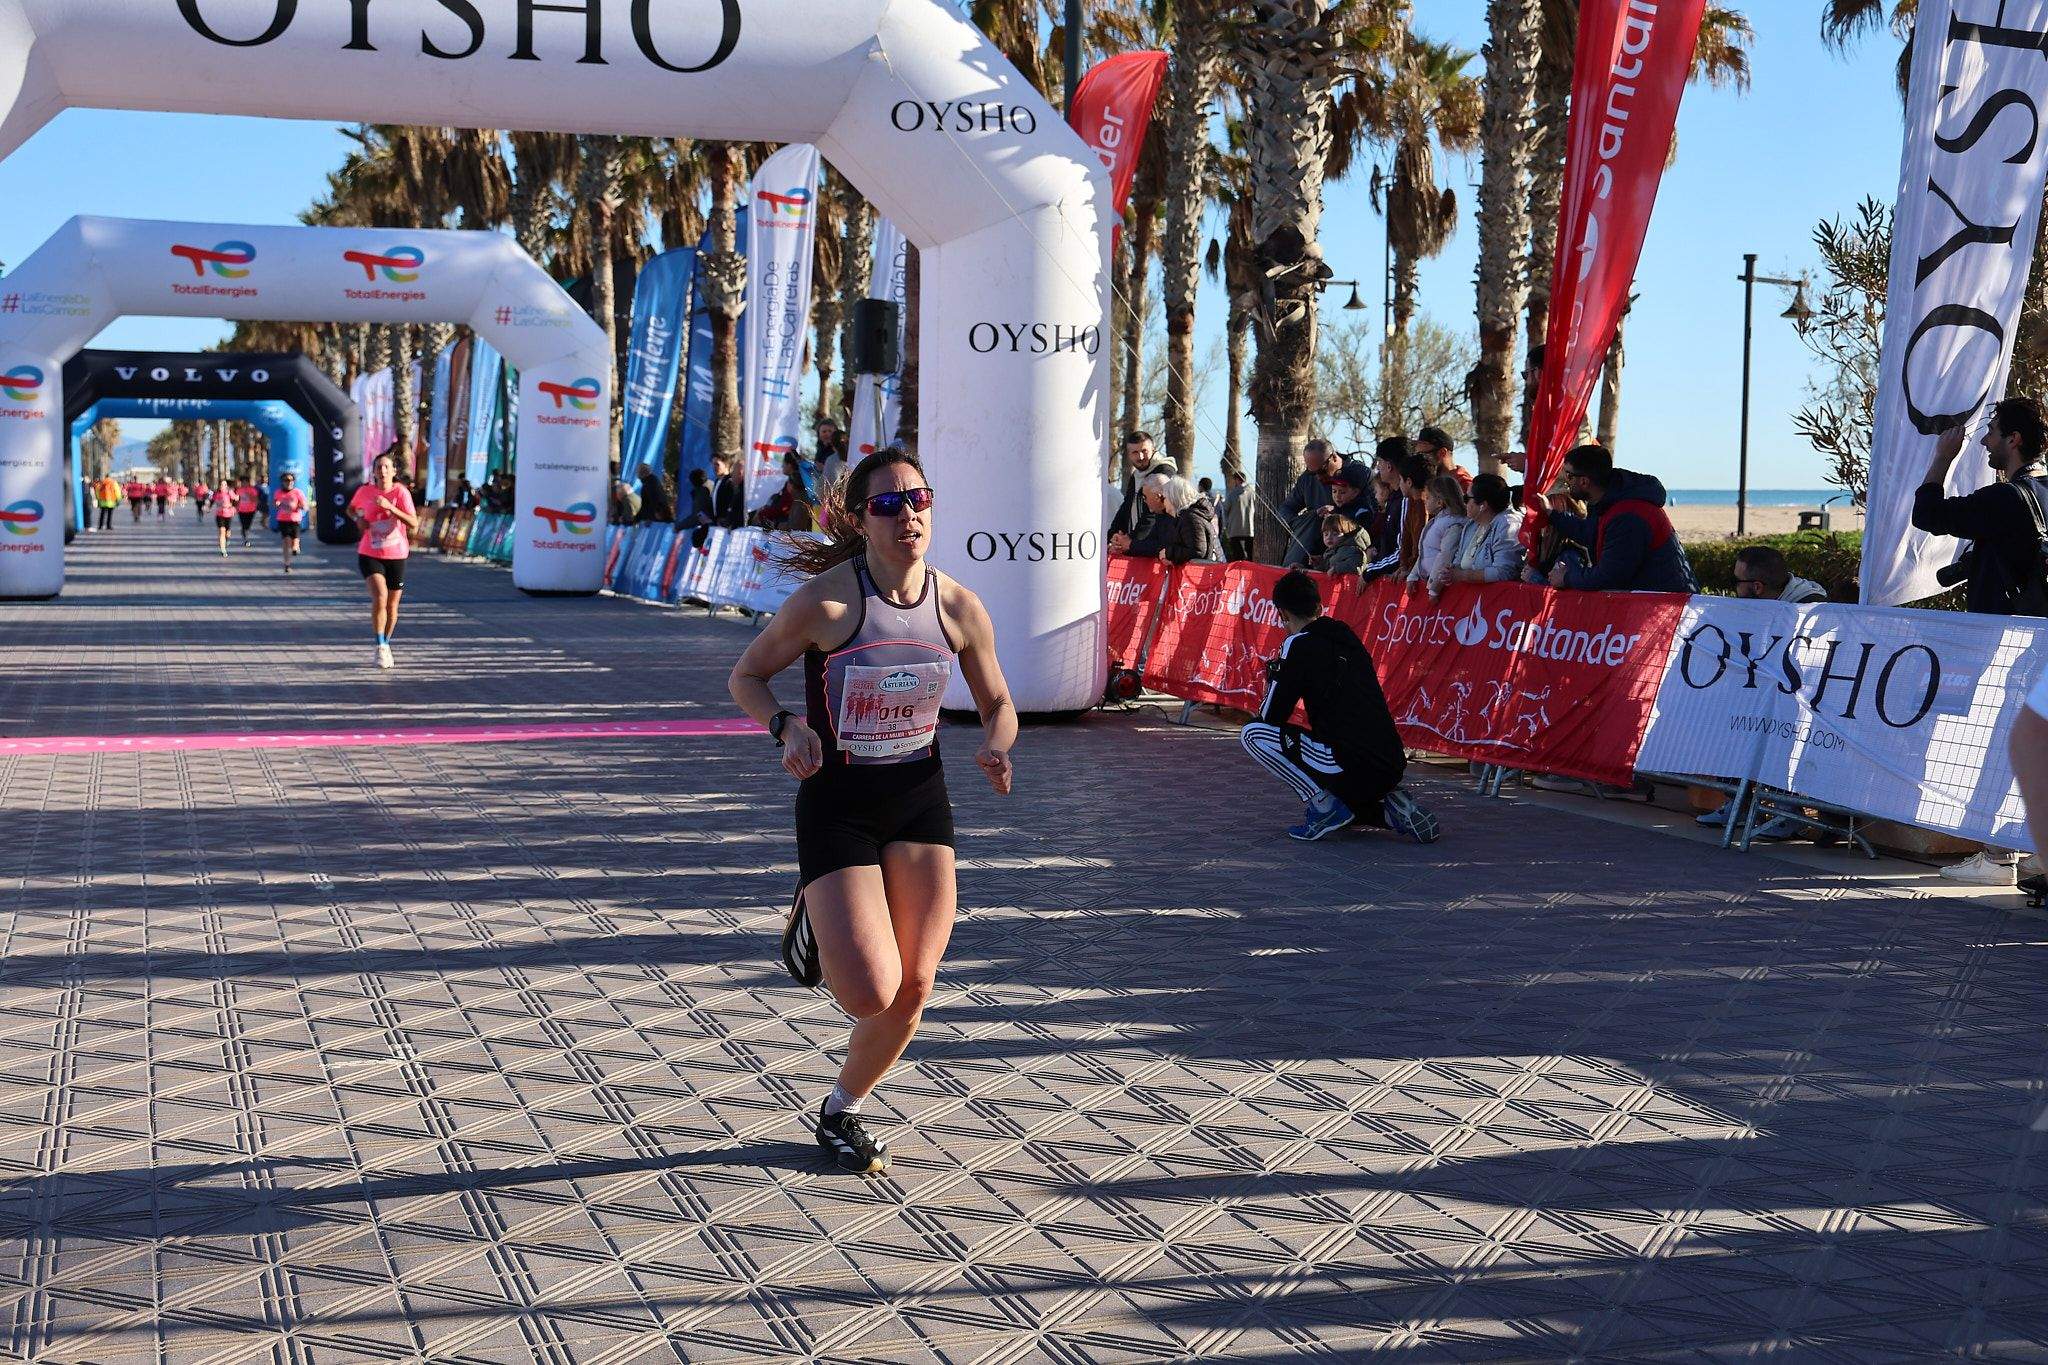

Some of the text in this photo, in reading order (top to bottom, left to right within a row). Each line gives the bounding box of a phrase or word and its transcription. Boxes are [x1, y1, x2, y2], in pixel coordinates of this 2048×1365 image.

[890, 99, 1037, 135] OYSHO
[171, 283, 258, 298] TotalEnergies
[344, 288, 426, 301] TotalEnergies
[968, 322, 1101, 355] OYSHO
[114, 366, 270, 383] VOLVO
[331, 427, 345, 528] VOLVO
[532, 539, 597, 552] TotalEnergies
[966, 530, 1097, 562] OYSHO
[1174, 582, 1227, 622] Sports
[1377, 602, 1641, 667] Sports Santander
[1680, 622, 1942, 728] OYSHO
[849, 743, 883, 752] OYSHO
